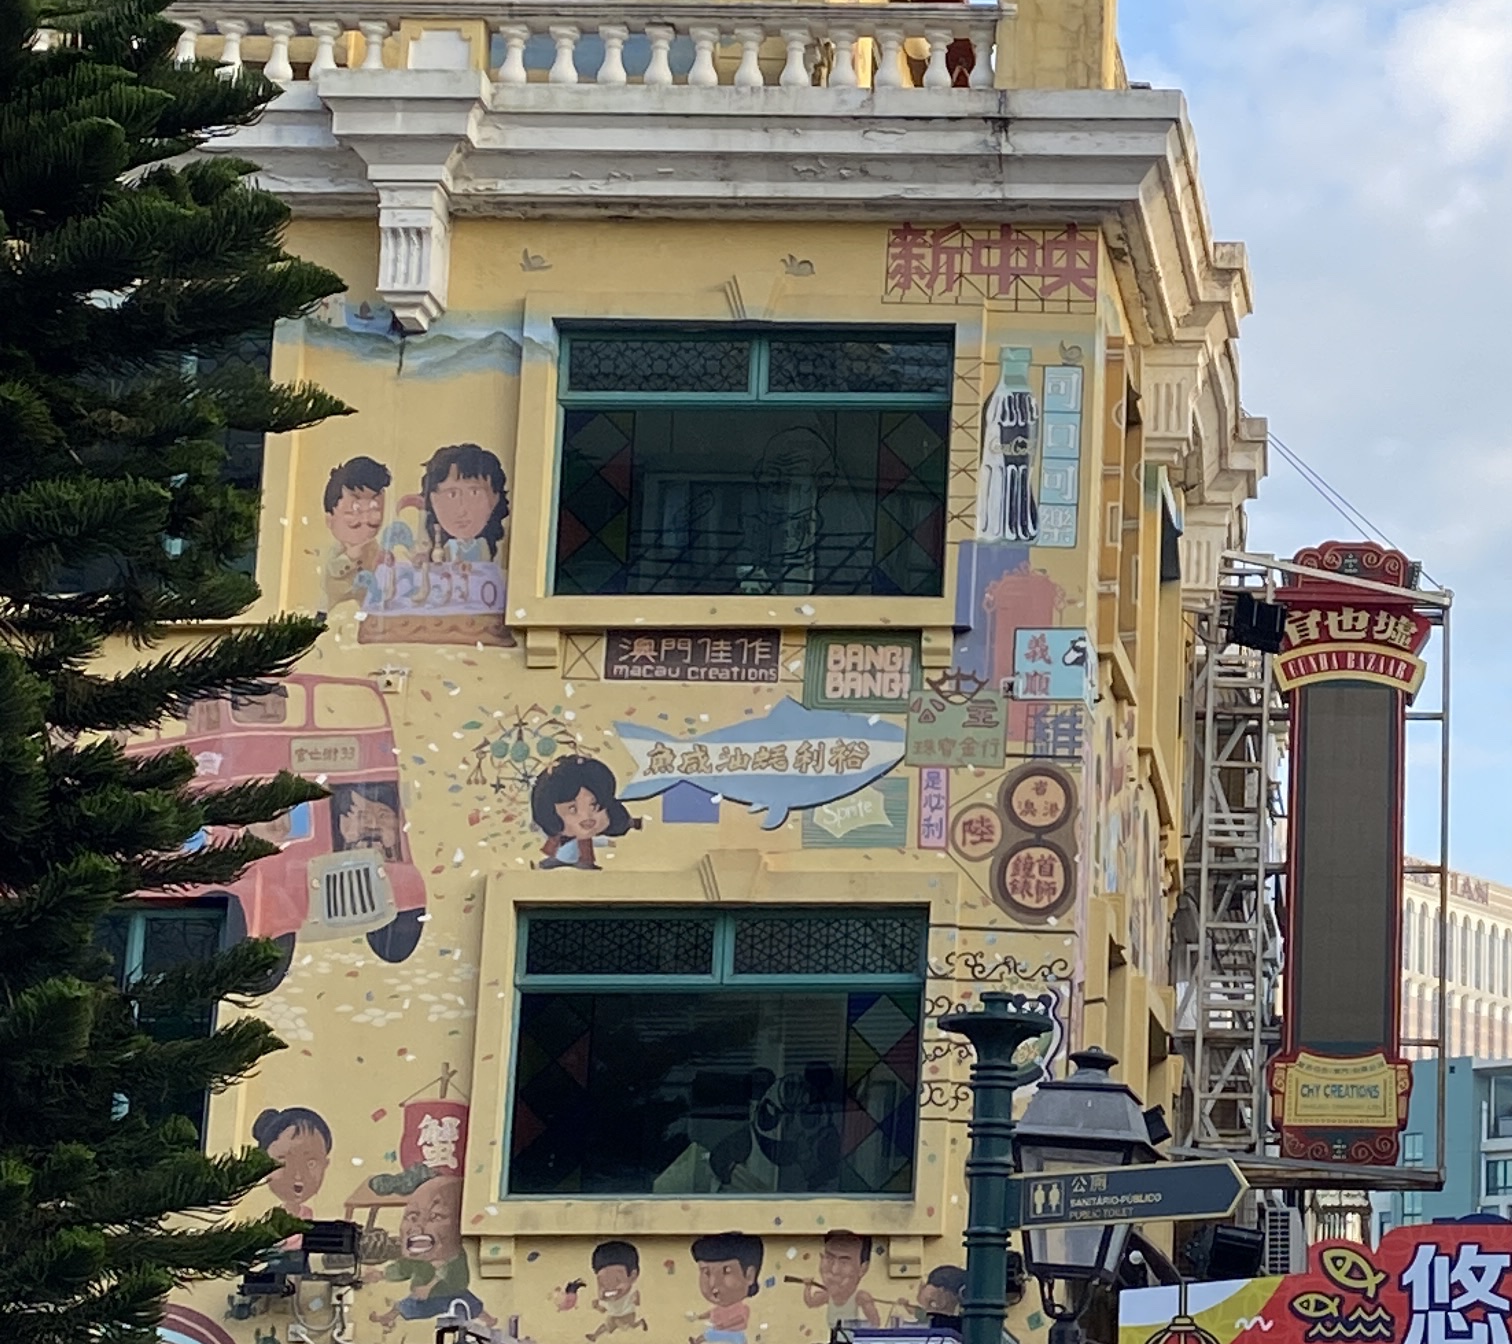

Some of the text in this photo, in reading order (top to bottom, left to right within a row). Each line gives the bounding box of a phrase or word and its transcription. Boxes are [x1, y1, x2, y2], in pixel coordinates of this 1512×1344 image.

[890, 222, 1098, 298] 新中央
[1347, 652, 1408, 680] BAZAAR
[823, 793, 873, 828] Sprite
[1323, 1084, 1380, 1099] CREATIONS
[1069, 1207, 1134, 1220] PUBLIC TOILET
